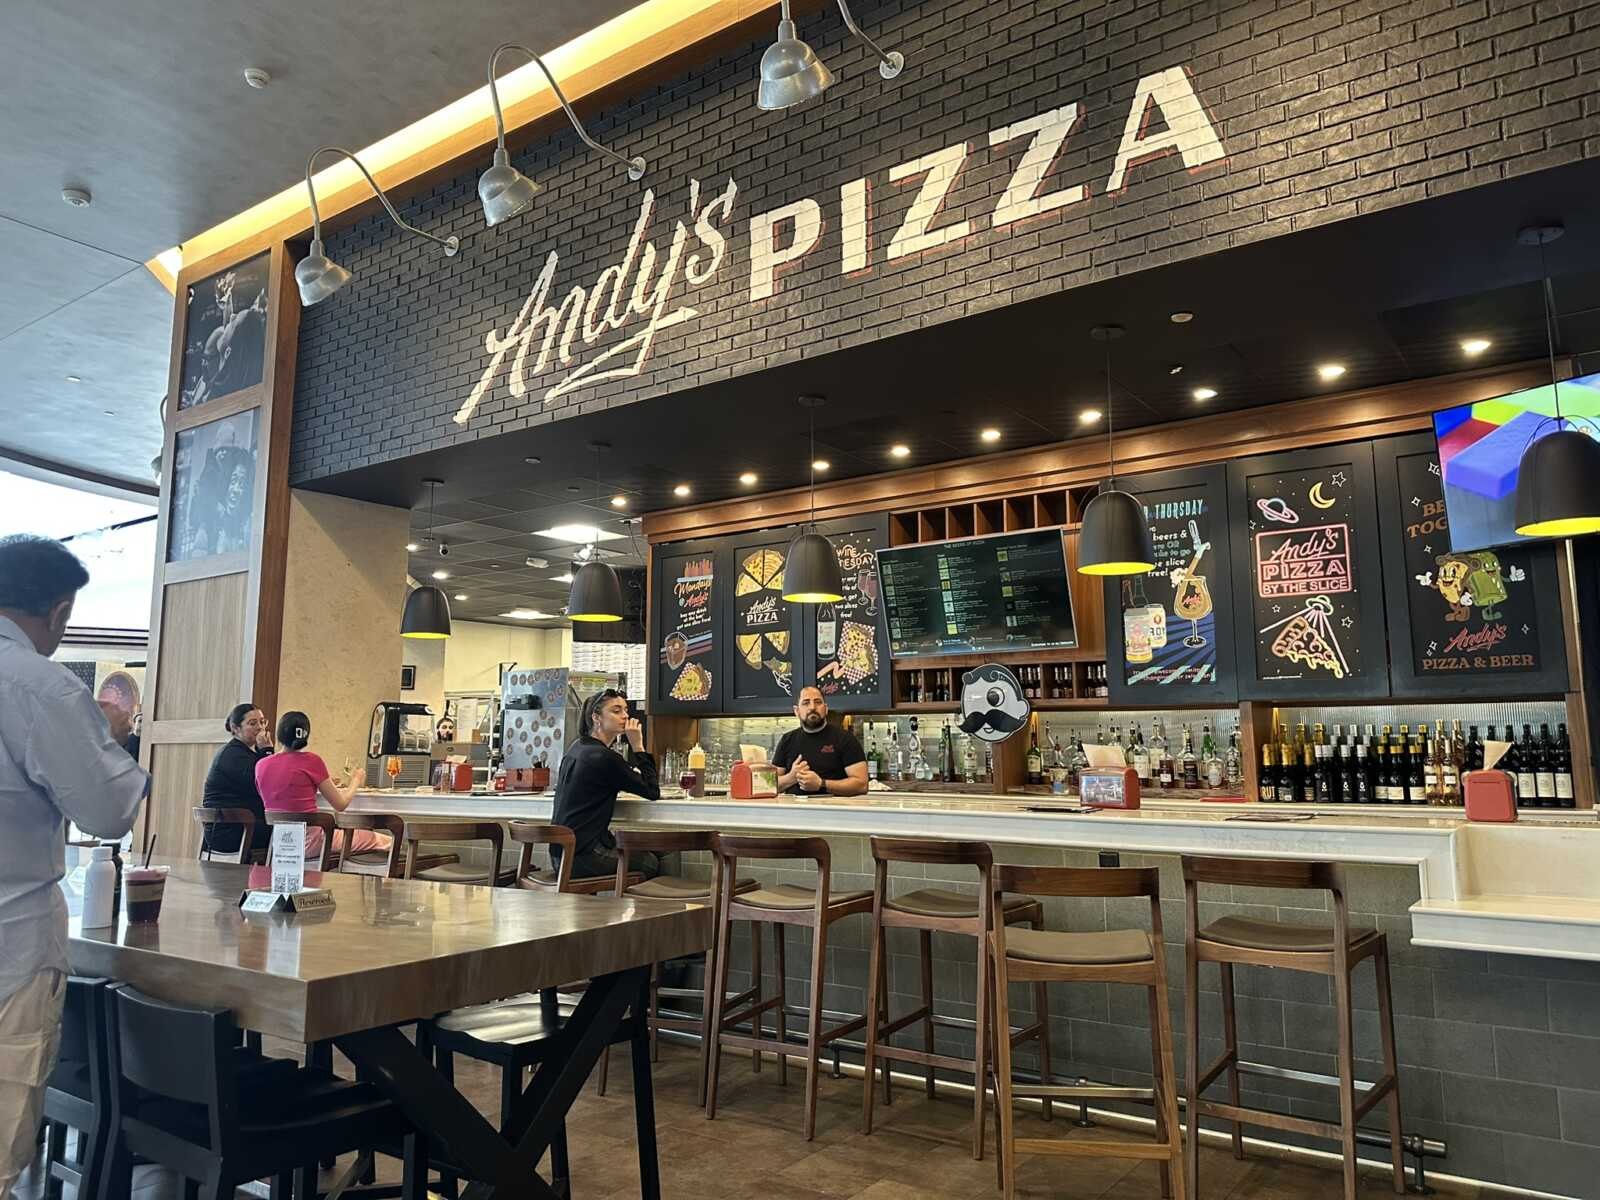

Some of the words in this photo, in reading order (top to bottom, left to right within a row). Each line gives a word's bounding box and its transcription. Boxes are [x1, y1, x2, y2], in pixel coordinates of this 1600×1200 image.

[453, 177, 738, 424] Andy's
[748, 65, 1230, 303] PIZZA
[1155, 499, 1203, 519] THURSDAY
[1152, 533, 1178, 541] beers
[1180, 529, 1187, 538] &
[1270, 528, 1339, 563] Andy's
[1166, 557, 1185, 567] slice
[1263, 560, 1345, 580] PIZZA
[1263, 584, 1279, 595] BY
[1282, 580, 1307, 593] THE
[1309, 577, 1348, 592] SLICE
[748, 595, 777, 614] Andy's
[746, 611, 778, 624] PIZZA
[1444, 624, 1508, 652] Andy's
[1423, 656, 1470, 670] PIZZA
[1474, 655, 1486, 668] &
[1489, 654, 1535, 668] BEER
